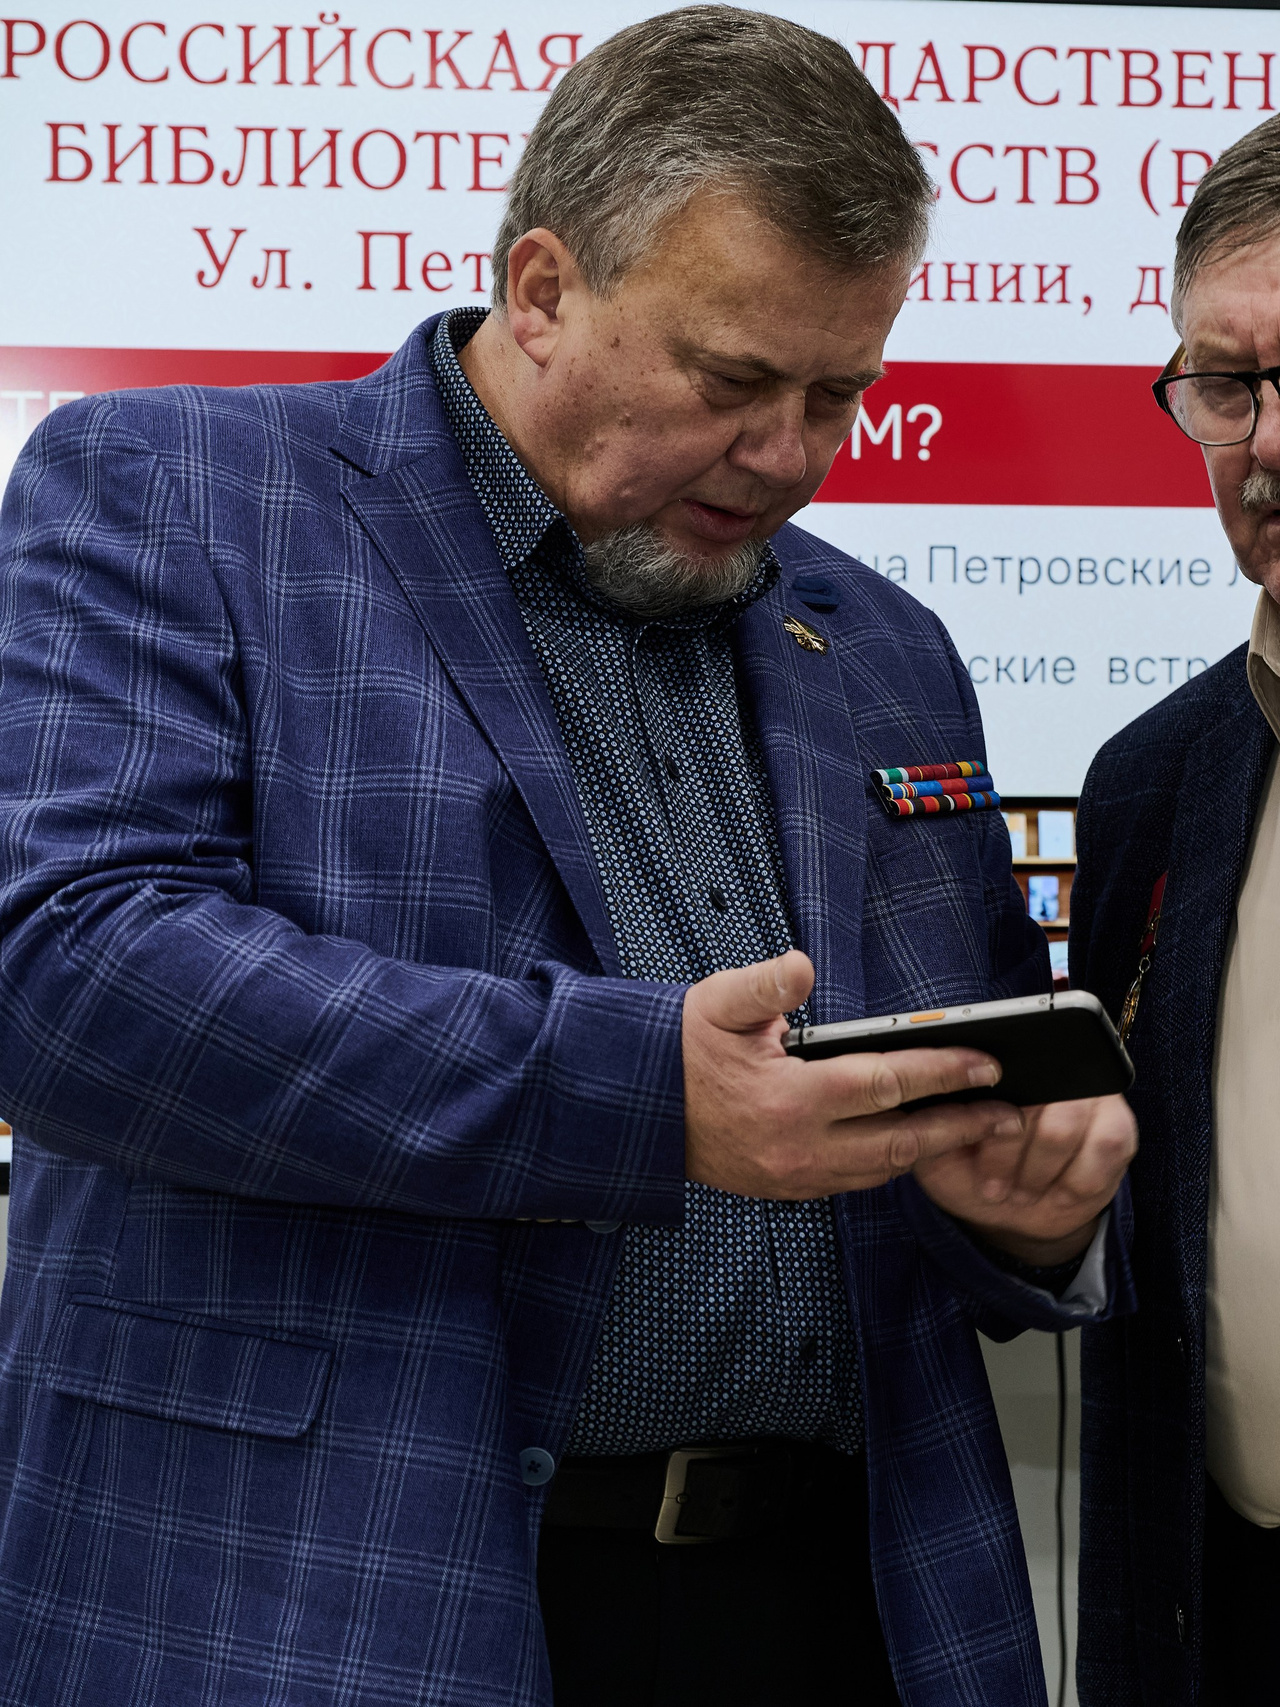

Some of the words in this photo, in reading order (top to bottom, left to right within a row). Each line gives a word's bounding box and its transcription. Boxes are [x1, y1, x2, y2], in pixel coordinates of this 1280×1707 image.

[0, 13, 583, 92] РОССИЙСКАЯ
[44, 121, 531, 193] БИБЛИОТЕ
[1139, 138, 1224, 217] (Р
[192, 227, 313, 291] Ул.
[356, 230, 492, 293] Пет
[851, 403, 943, 461] М?
[929, 545, 1212, 595] Петровские
[968, 655, 1077, 685] ские
